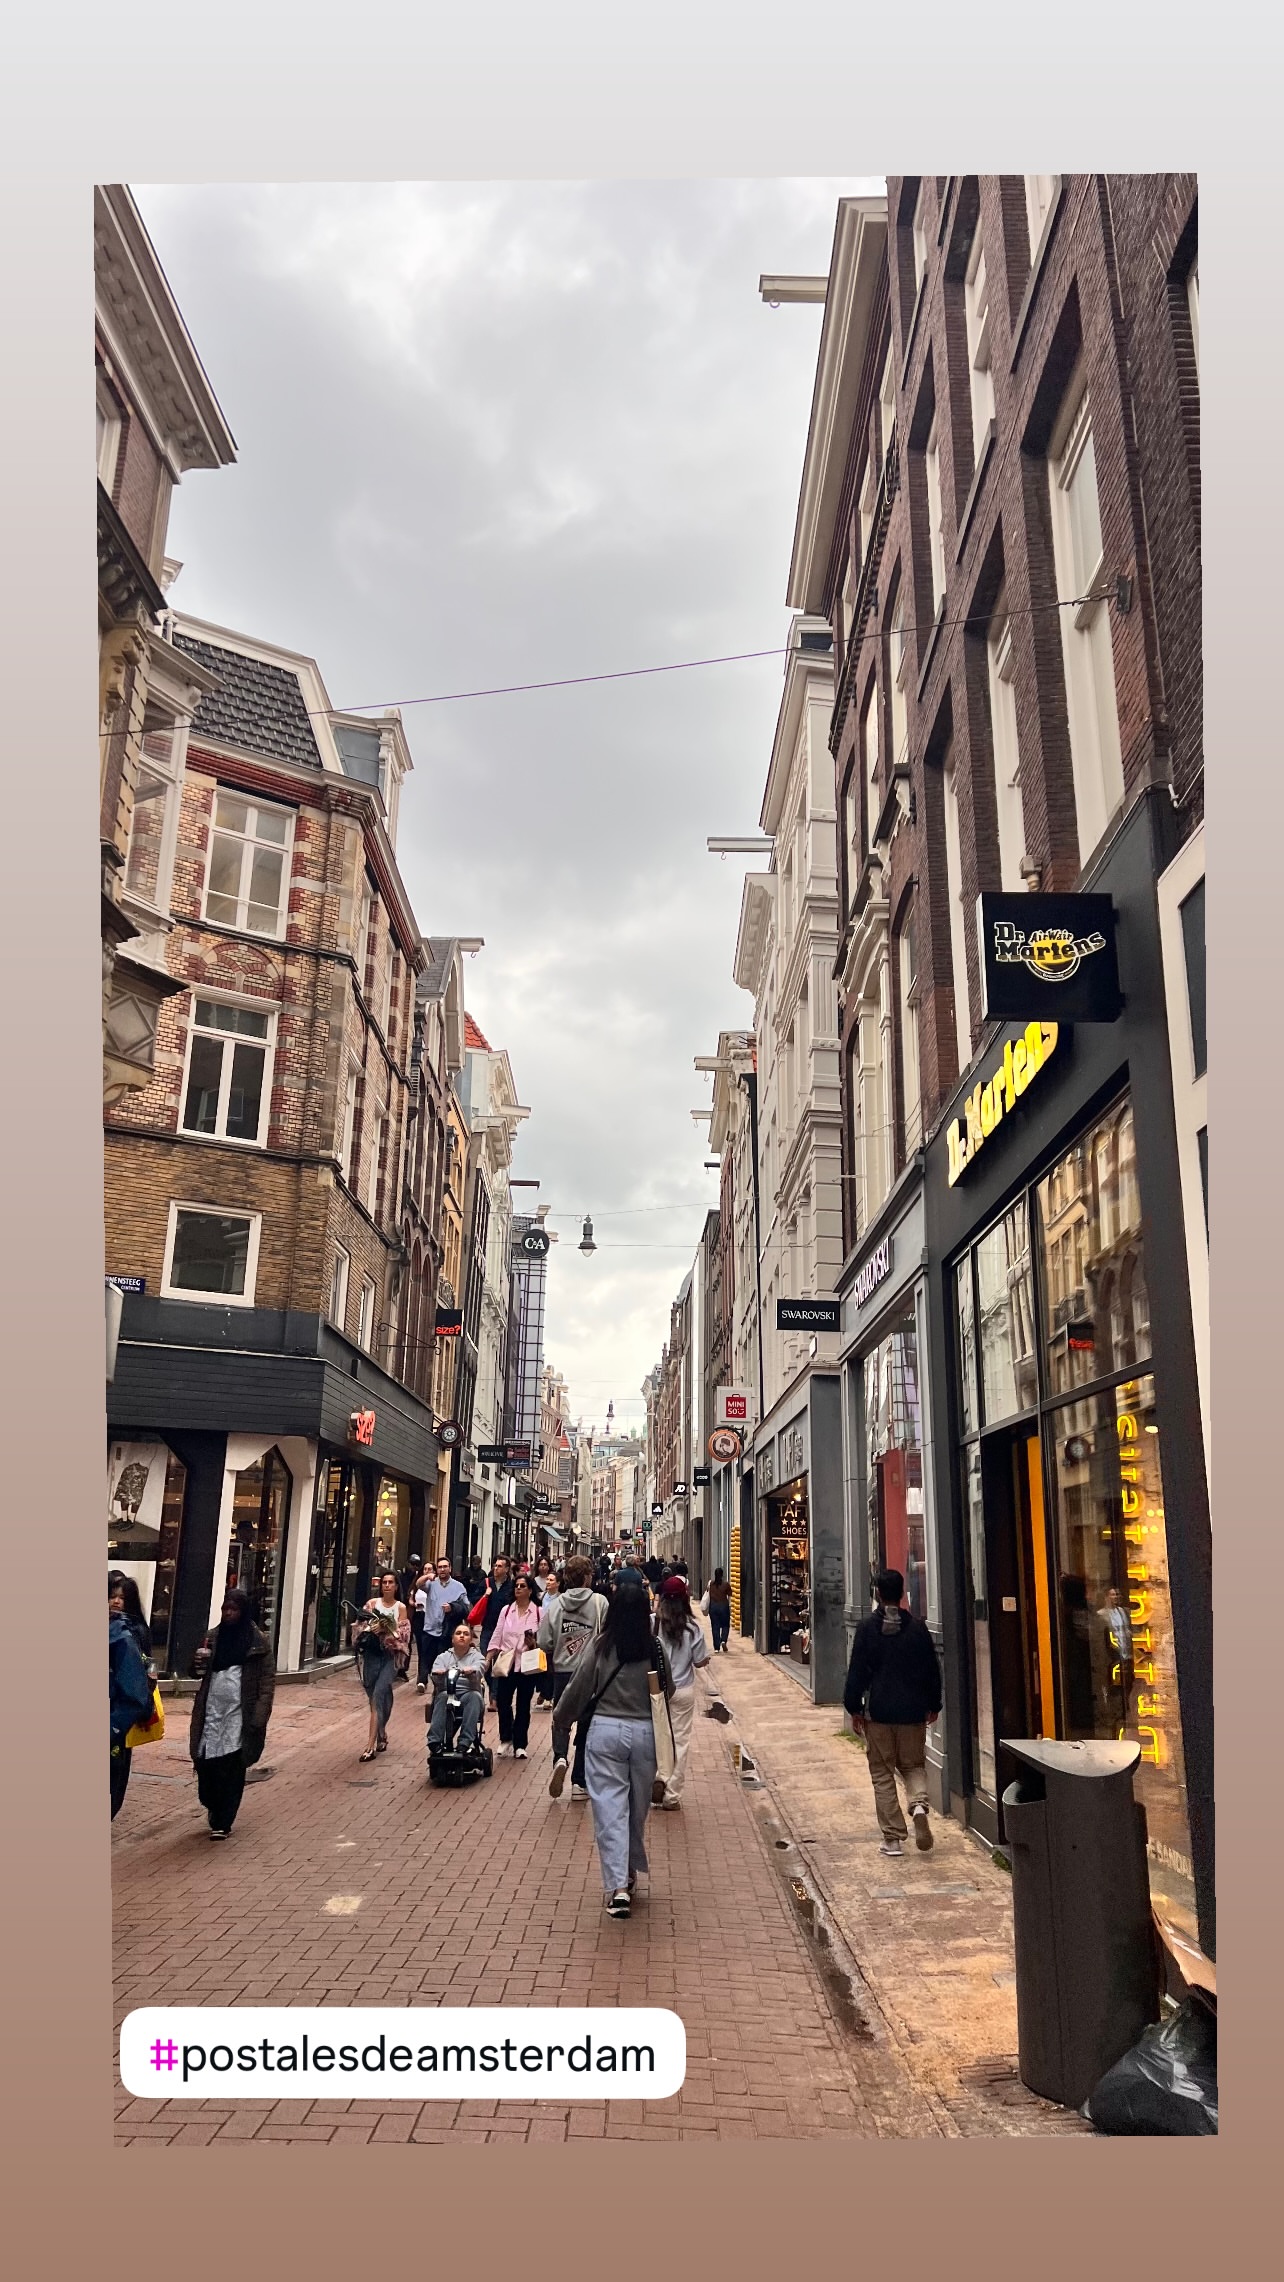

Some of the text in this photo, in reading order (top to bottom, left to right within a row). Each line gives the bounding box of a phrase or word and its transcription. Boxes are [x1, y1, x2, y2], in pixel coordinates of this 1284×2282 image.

[994, 922, 1025, 943] Dr.
[1028, 928, 1074, 945] AirWair
[994, 931, 1106, 962] Martens
[525, 1237, 545, 1250] C&A
[854, 1236, 889, 1311] SWAROVSKI
[781, 1310, 835, 1321] SWAROVSKI
[435, 1325, 461, 1335] size?
[727, 1400, 745, 1408] MINI
[355, 1410, 375, 1446] size?
[674, 1484, 686, 1493] JD
[781, 1526, 807, 1535] SHOES
